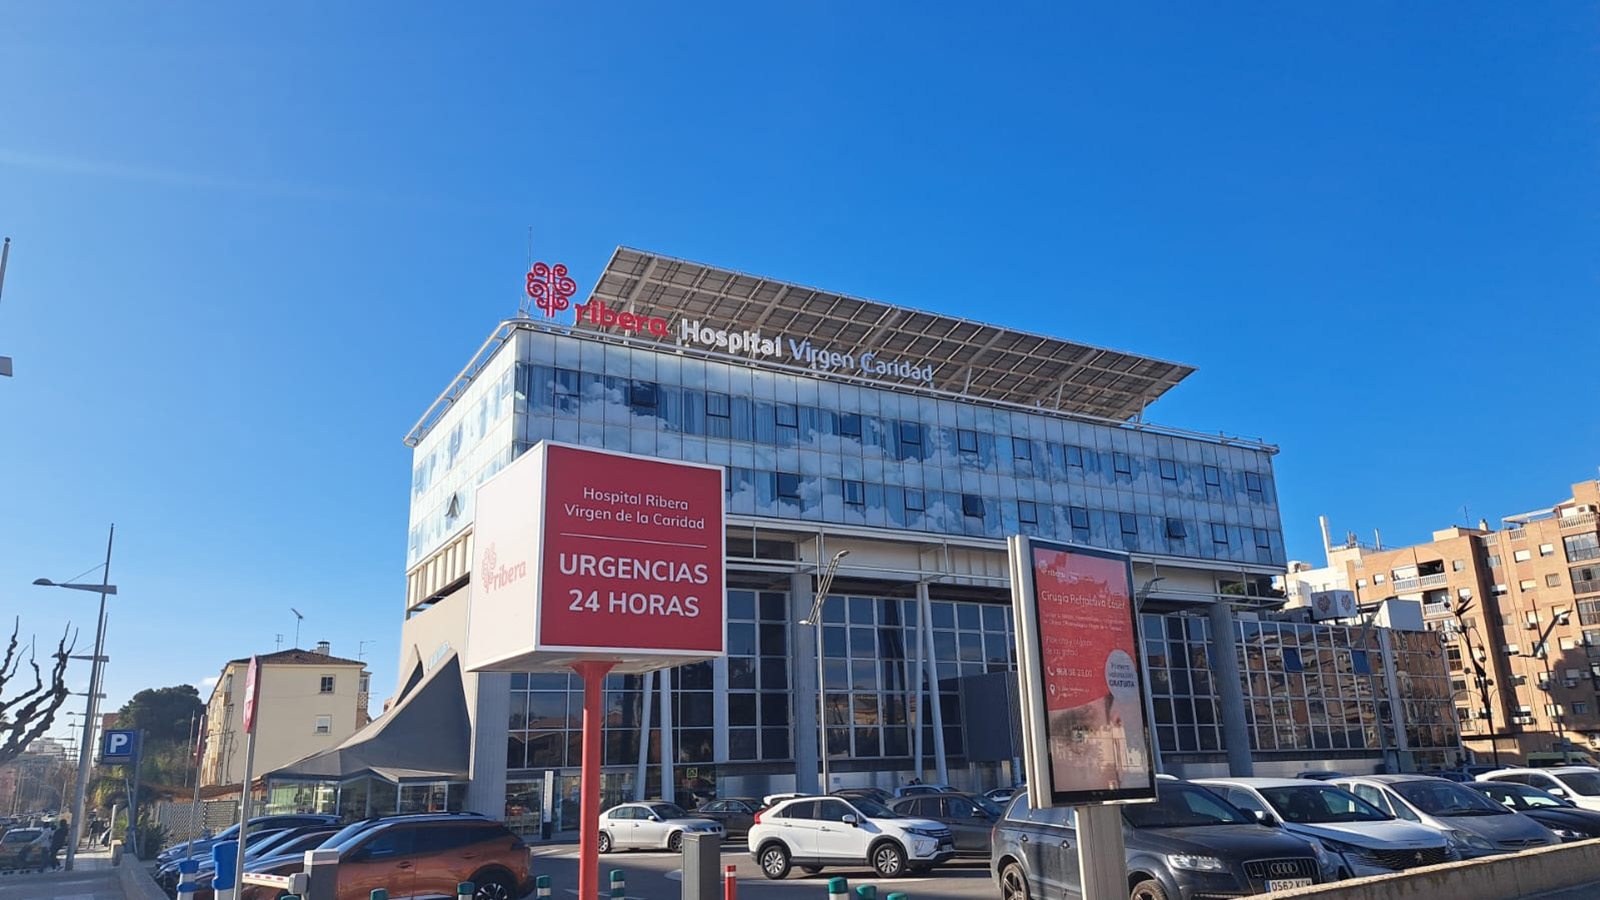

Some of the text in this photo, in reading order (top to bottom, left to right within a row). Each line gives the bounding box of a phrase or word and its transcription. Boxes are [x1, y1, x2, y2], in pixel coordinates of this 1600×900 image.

[575, 300, 934, 382] ribera Hospital Virgen Caridad
[583, 487, 689, 510] Hospital Ribera
[564, 503, 706, 530] Virgen de la Caridad
[493, 560, 527, 591] ribera
[559, 553, 709, 584] URGENCIAS
[568, 588, 700, 618] 24 HORAS
[110, 733, 128, 753] P
